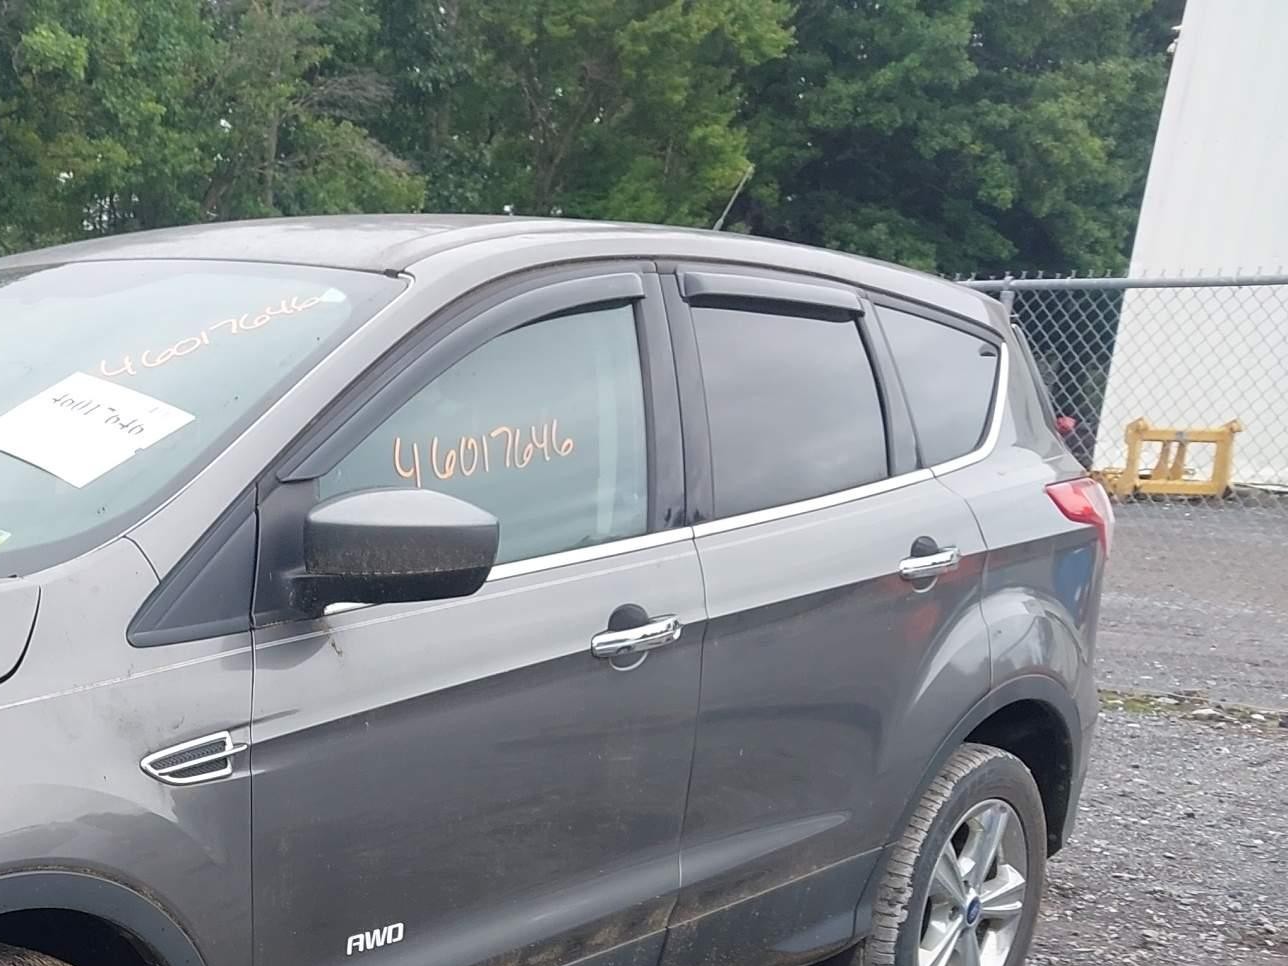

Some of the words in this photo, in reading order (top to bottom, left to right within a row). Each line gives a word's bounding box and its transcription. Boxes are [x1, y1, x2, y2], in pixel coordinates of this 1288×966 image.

[100, 296, 320, 375] 46017646
[394, 419, 573, 488] 46017646
[346, 922, 404, 955] AWD
